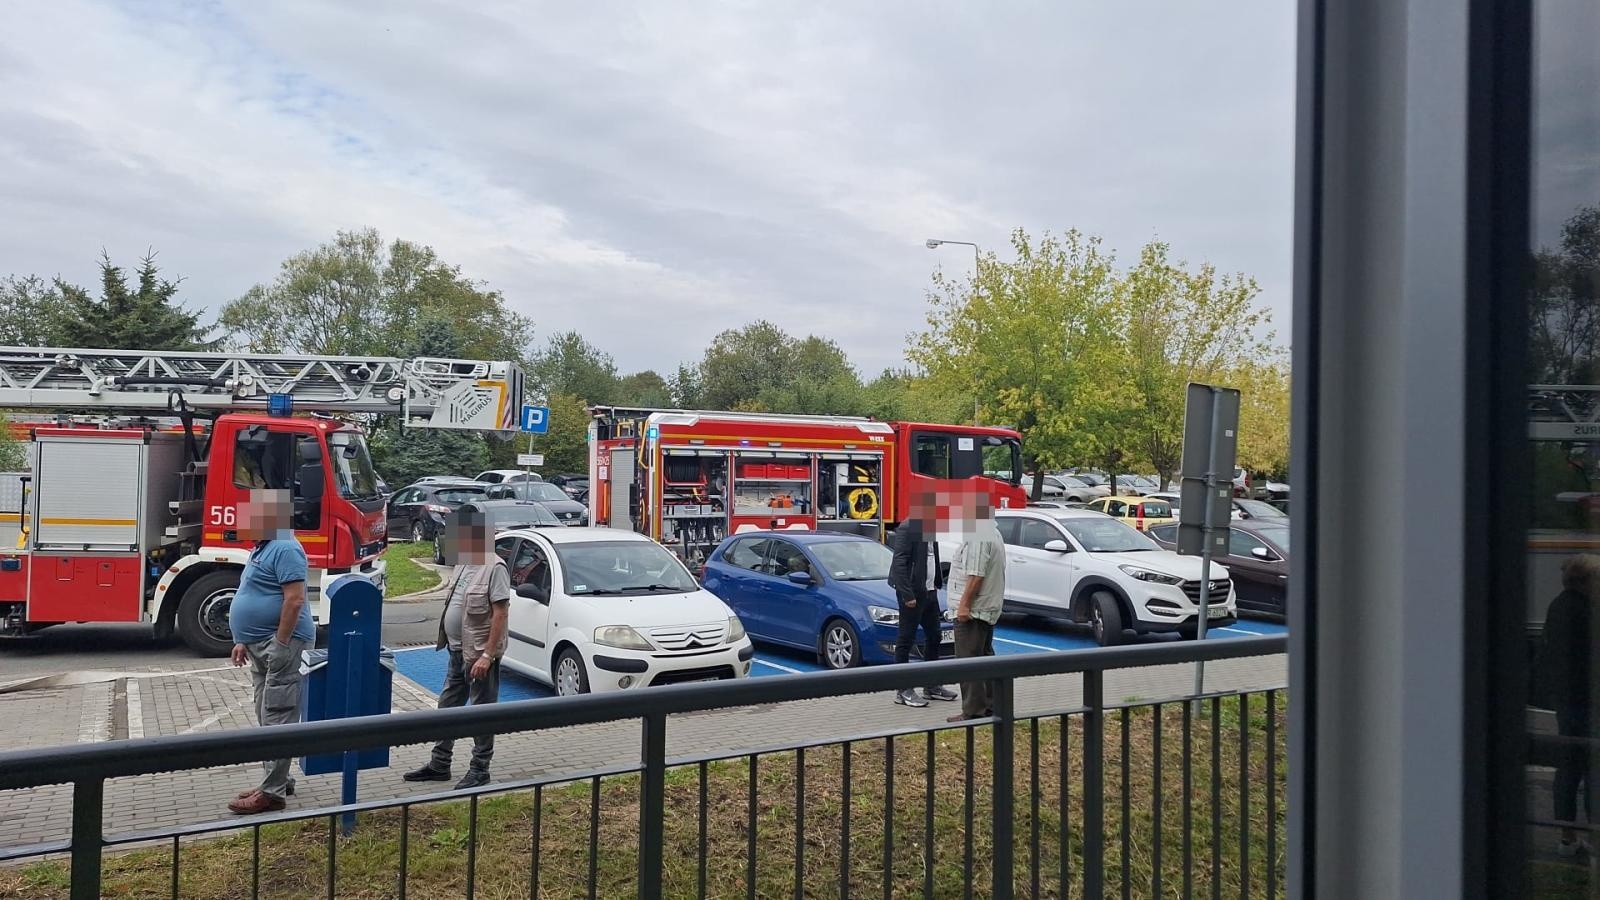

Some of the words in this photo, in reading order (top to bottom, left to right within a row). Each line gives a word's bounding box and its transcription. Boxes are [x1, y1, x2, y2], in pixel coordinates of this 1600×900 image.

[460, 397, 492, 424] MAGIRUS
[527, 409, 543, 429] P
[210, 505, 236, 526] 56
